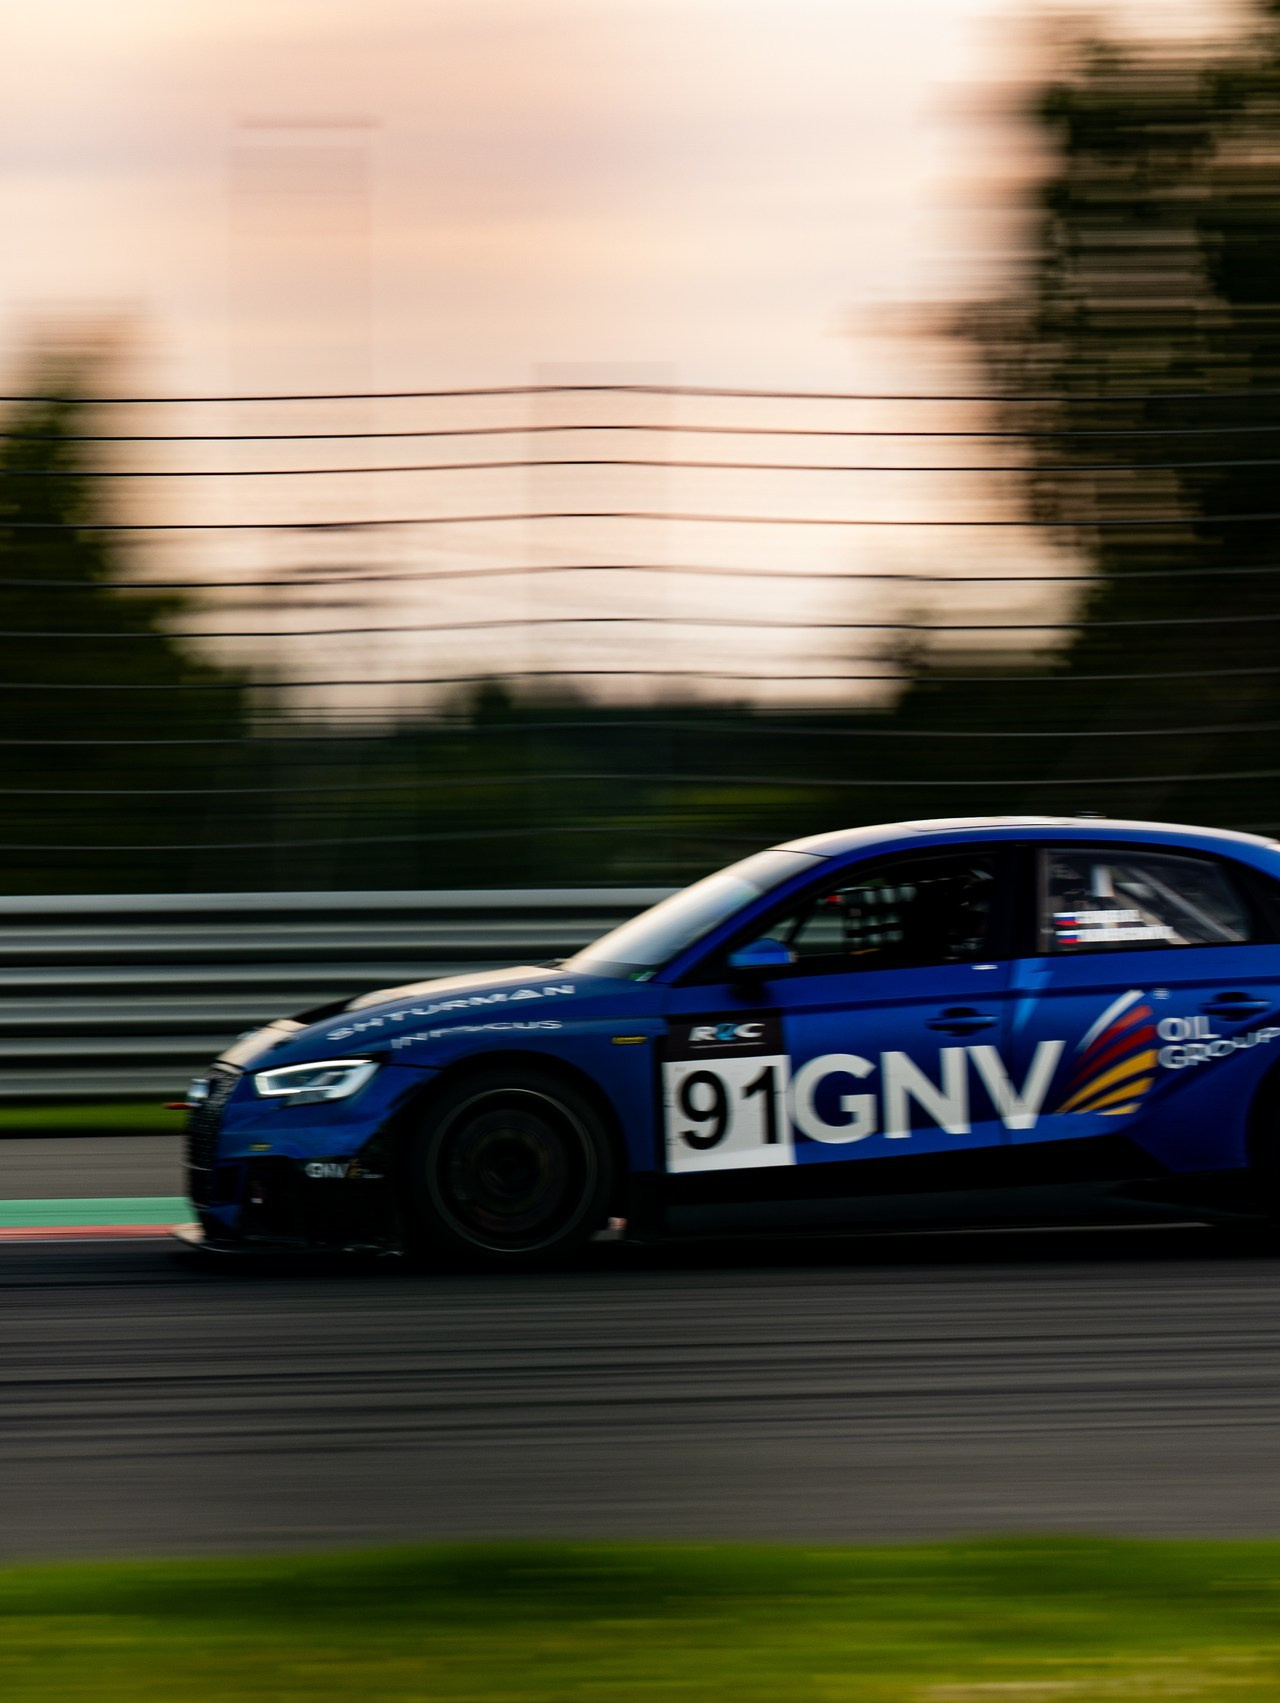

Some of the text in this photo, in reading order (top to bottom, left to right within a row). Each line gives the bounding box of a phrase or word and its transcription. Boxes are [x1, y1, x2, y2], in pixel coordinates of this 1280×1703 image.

[327, 984, 576, 1040] SHTURMAN
[1157, 1015, 1221, 1041] OIL
[674, 1065, 781, 1150] 91
[790, 1040, 1066, 1144] GNV
